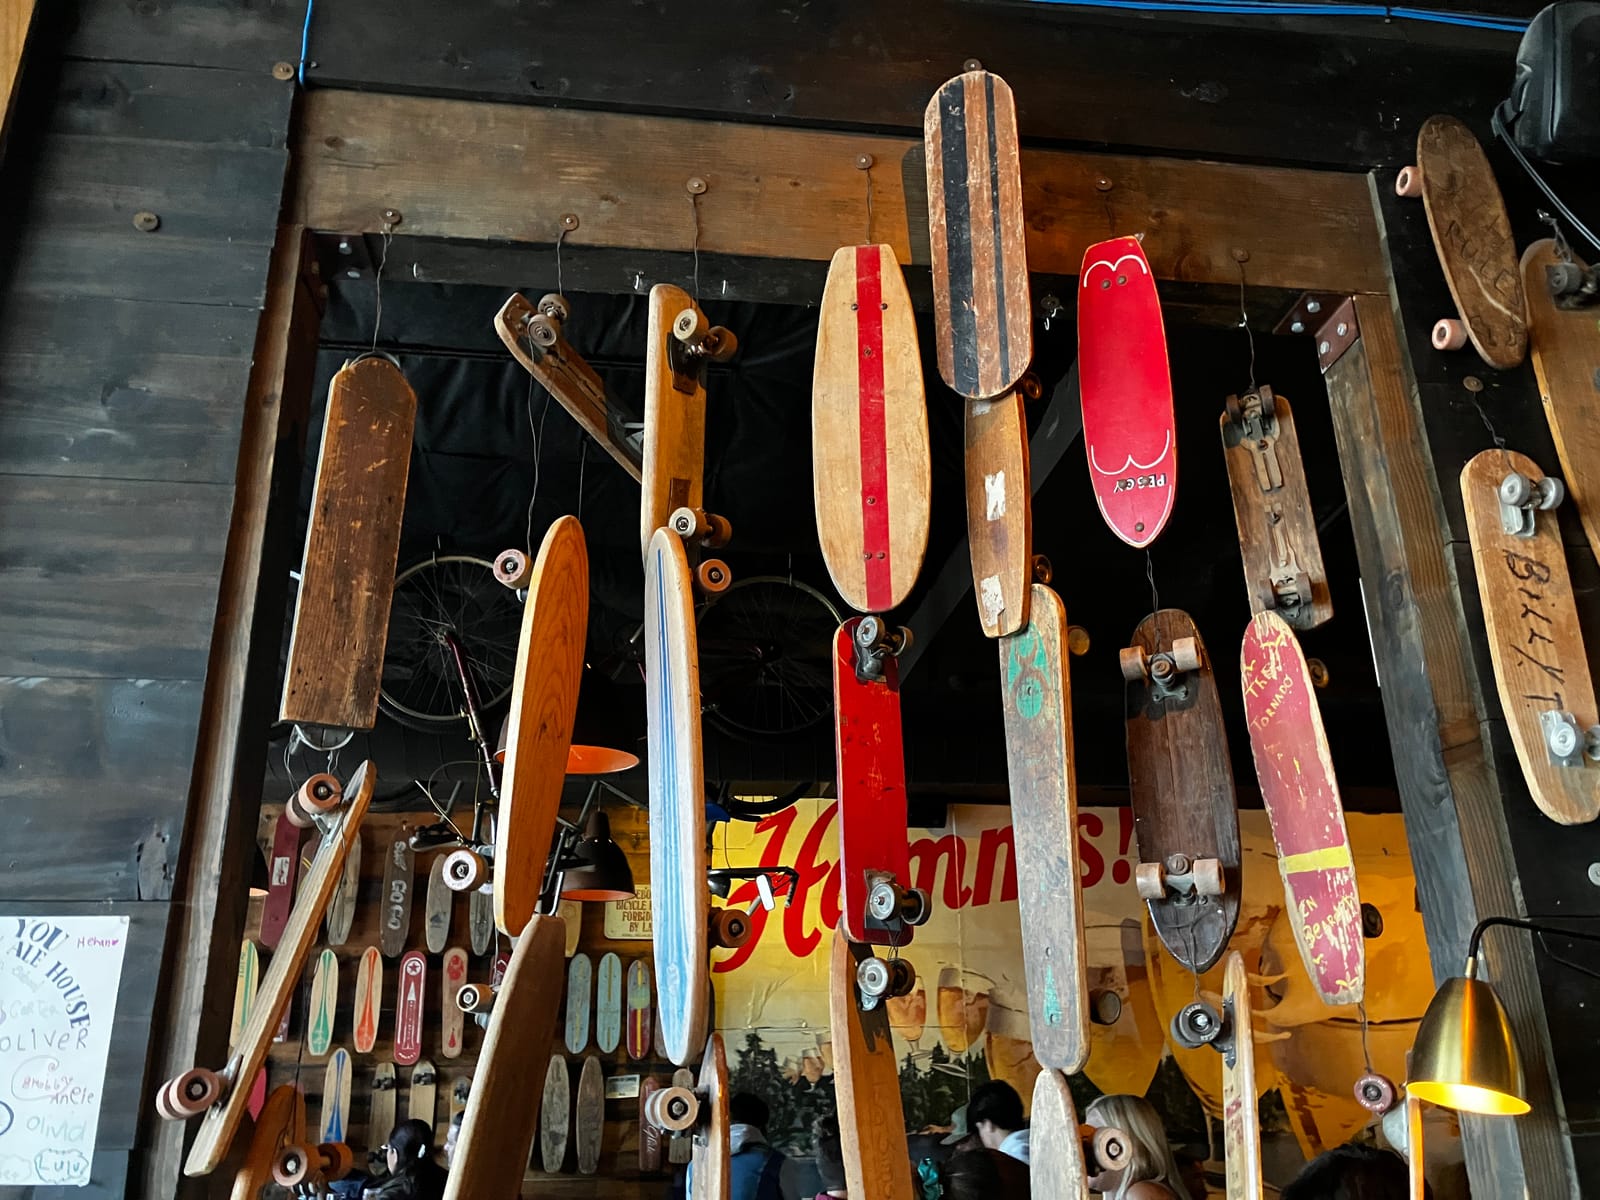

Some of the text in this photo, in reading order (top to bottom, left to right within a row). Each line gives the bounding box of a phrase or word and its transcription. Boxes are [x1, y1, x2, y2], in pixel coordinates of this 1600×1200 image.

[16, 918, 69, 951] YOU
[7, 941, 47, 968] ALE
[45, 960, 91, 1029] HOUSE
